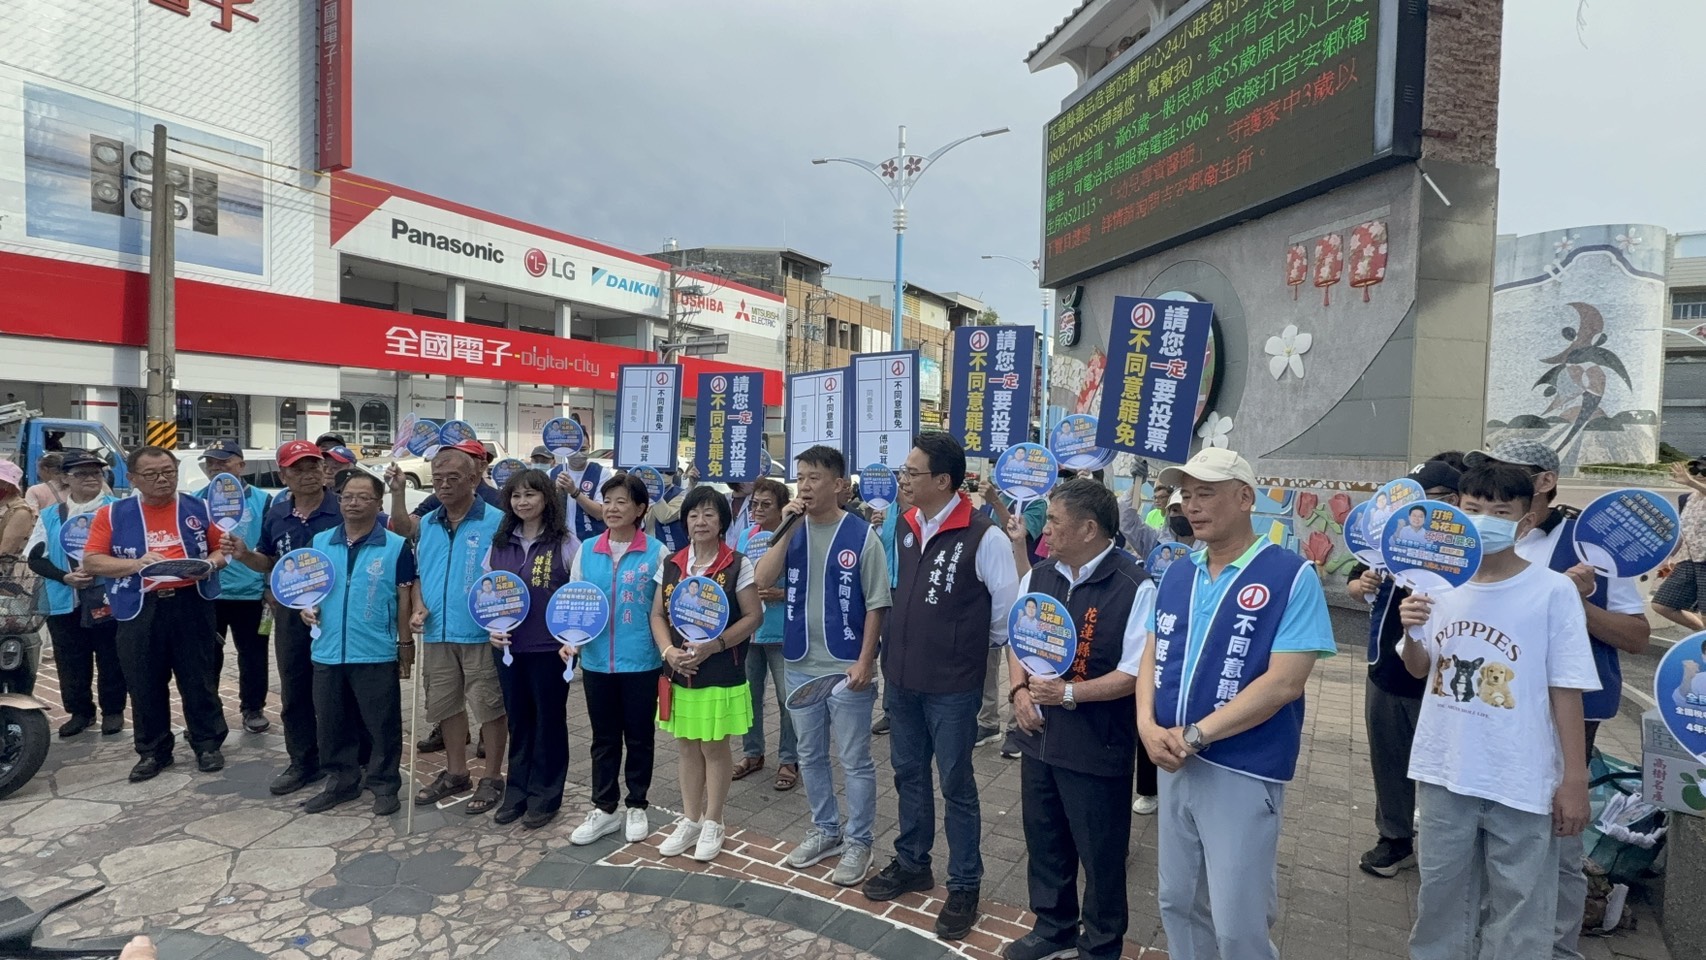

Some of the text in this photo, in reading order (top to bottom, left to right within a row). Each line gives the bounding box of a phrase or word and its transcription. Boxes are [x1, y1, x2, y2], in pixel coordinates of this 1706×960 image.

[391, 218, 504, 264] Panasonic
[551, 257, 575, 281] LG
[607, 274, 660, 298] DAIKIN
[751, 315, 776, 328] ELECTRIC
[893, 380, 903, 430] 不同意罷免
[964, 352, 988, 452] 不同意罷免
[989, 330, 1019, 453] 請您一定要投票
[1114, 329, 1151, 447] 不同意罷免
[1144, 306, 1190, 454] 請您一定要投票
[655, 389, 665, 431] 不同意罷免
[727, 376, 752, 477] 請您一定要投票
[825, 395, 835, 438] 不同意罷免
[707, 394, 726, 478] 不同意罷免
[925, 550, 946, 605] 吳建志
[1435, 620, 1522, 662] PUPPIES
